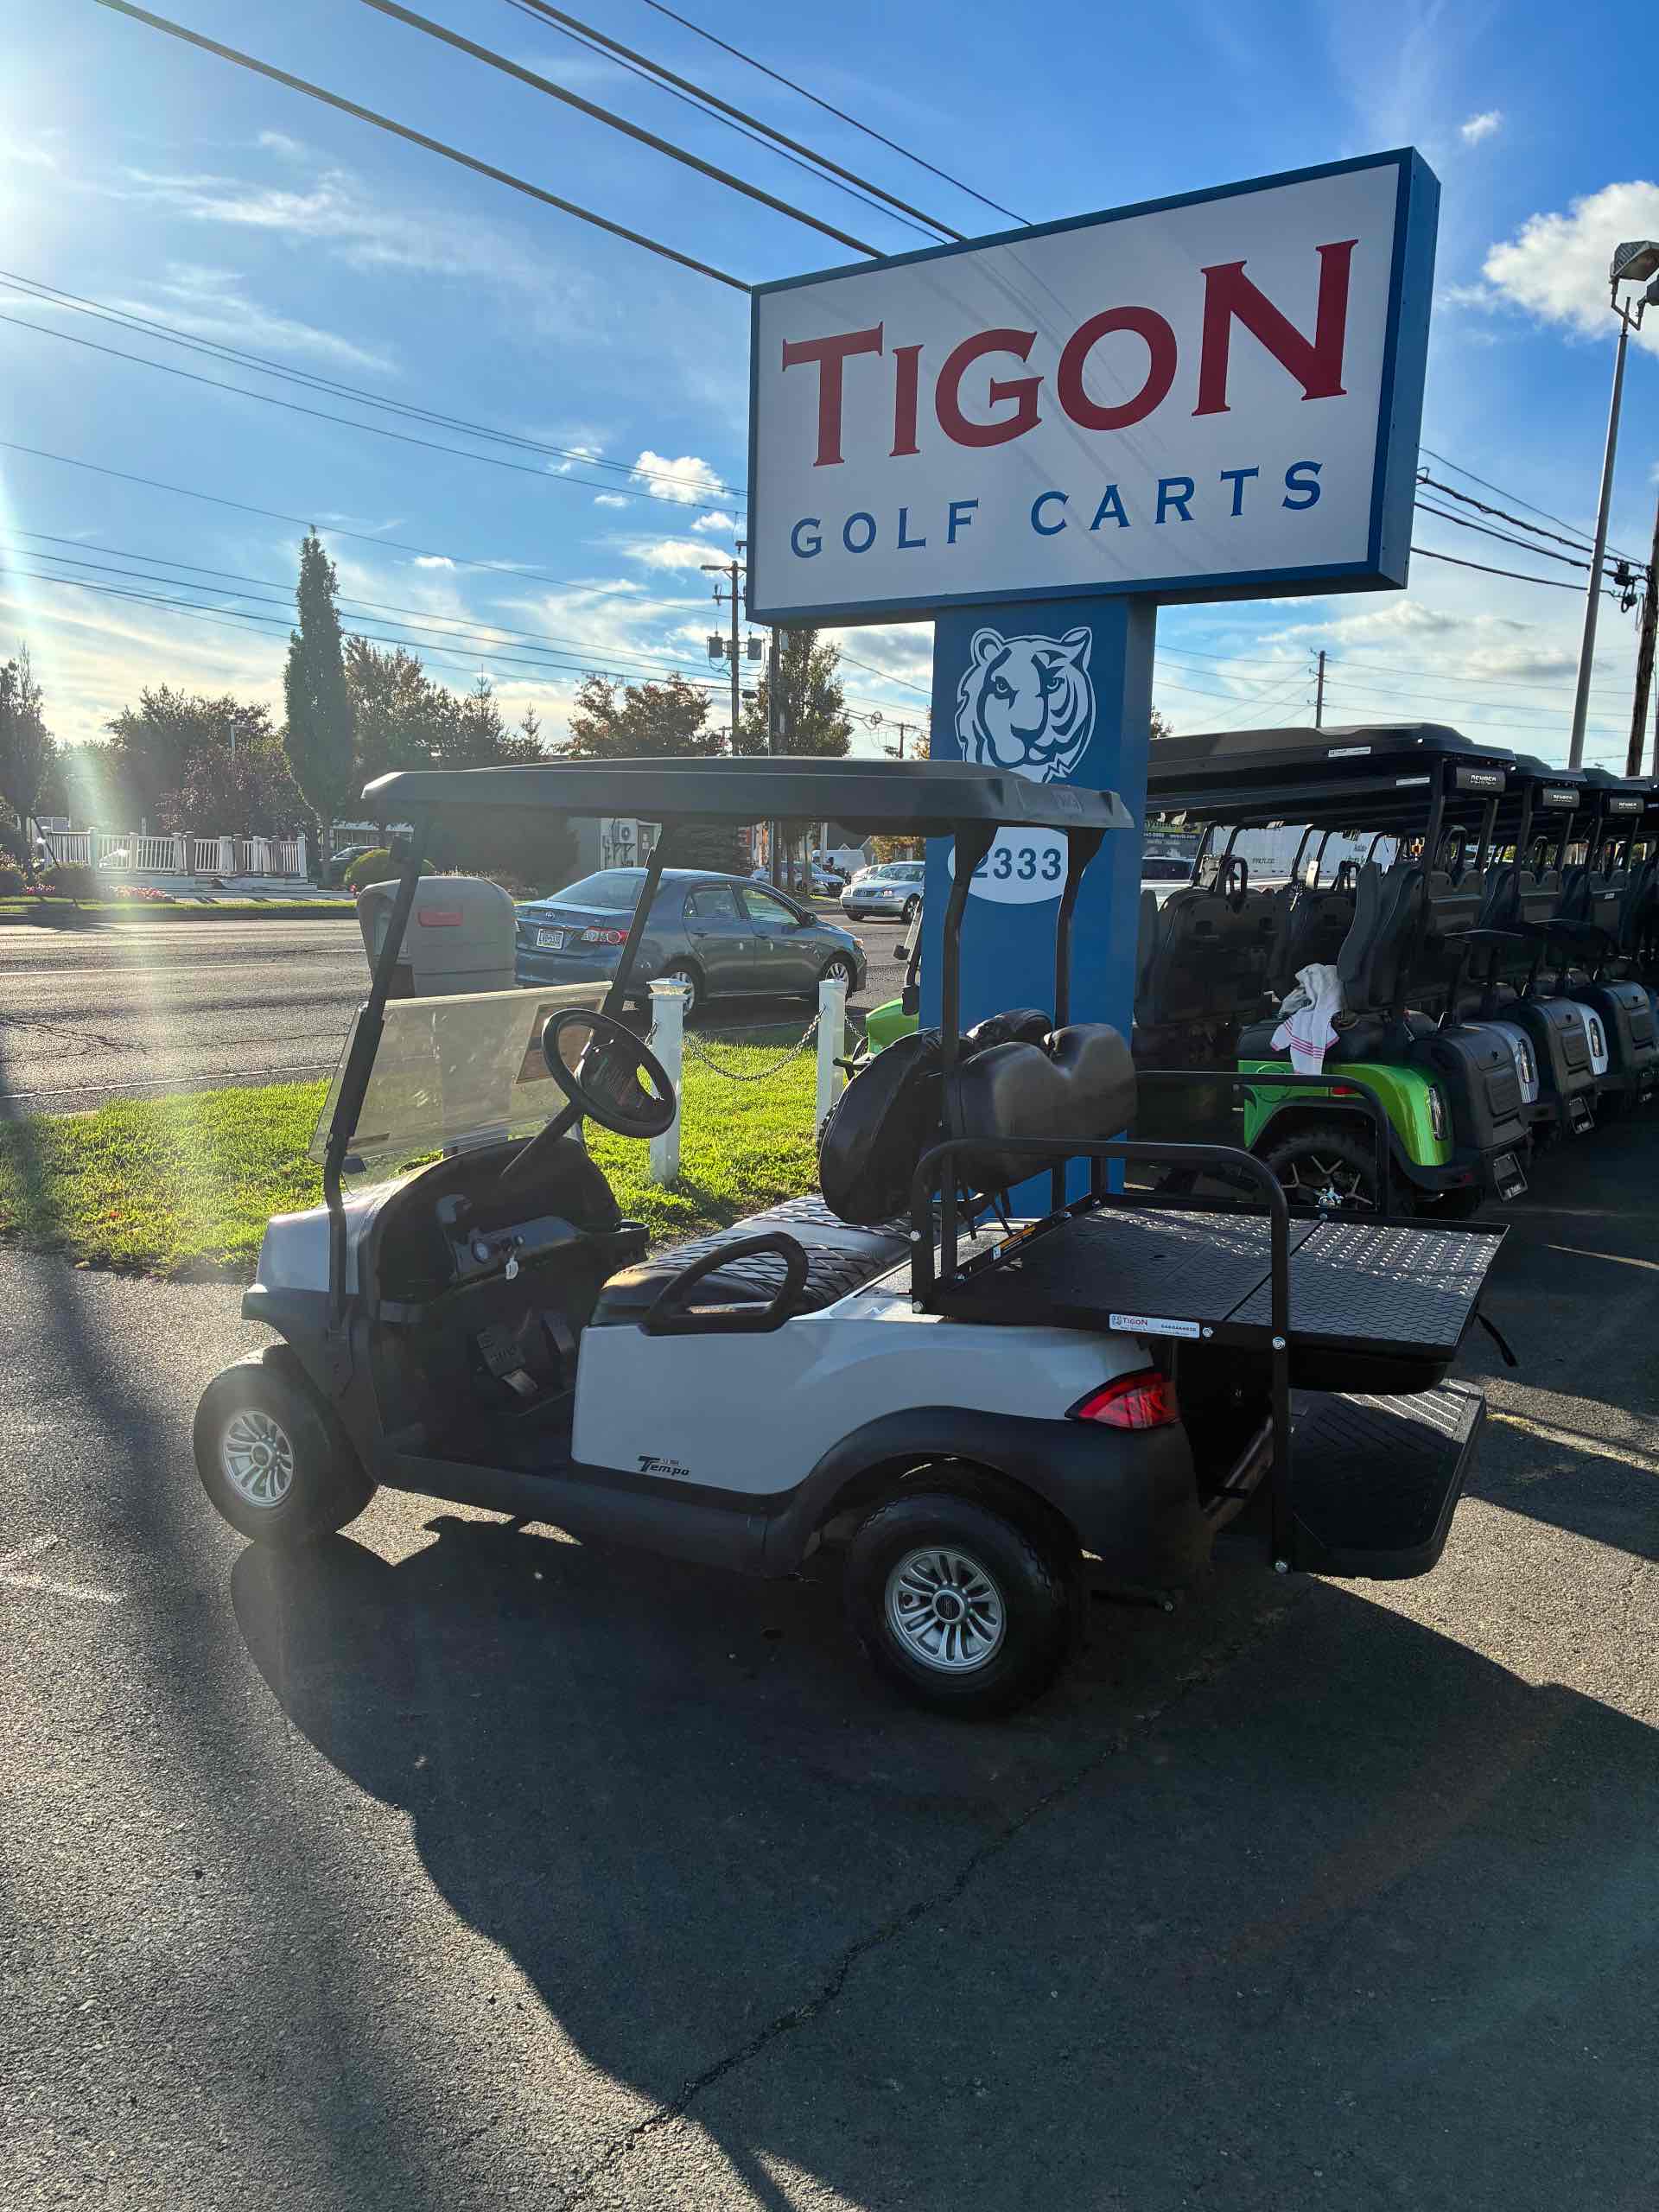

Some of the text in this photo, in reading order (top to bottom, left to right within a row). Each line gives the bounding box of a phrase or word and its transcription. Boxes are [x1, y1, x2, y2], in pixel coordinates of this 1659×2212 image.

[783, 239, 1359, 467] TIGON
[791, 461, 1324, 558] GOLF CARTS
[638, 1456, 690, 1476] Tempo
